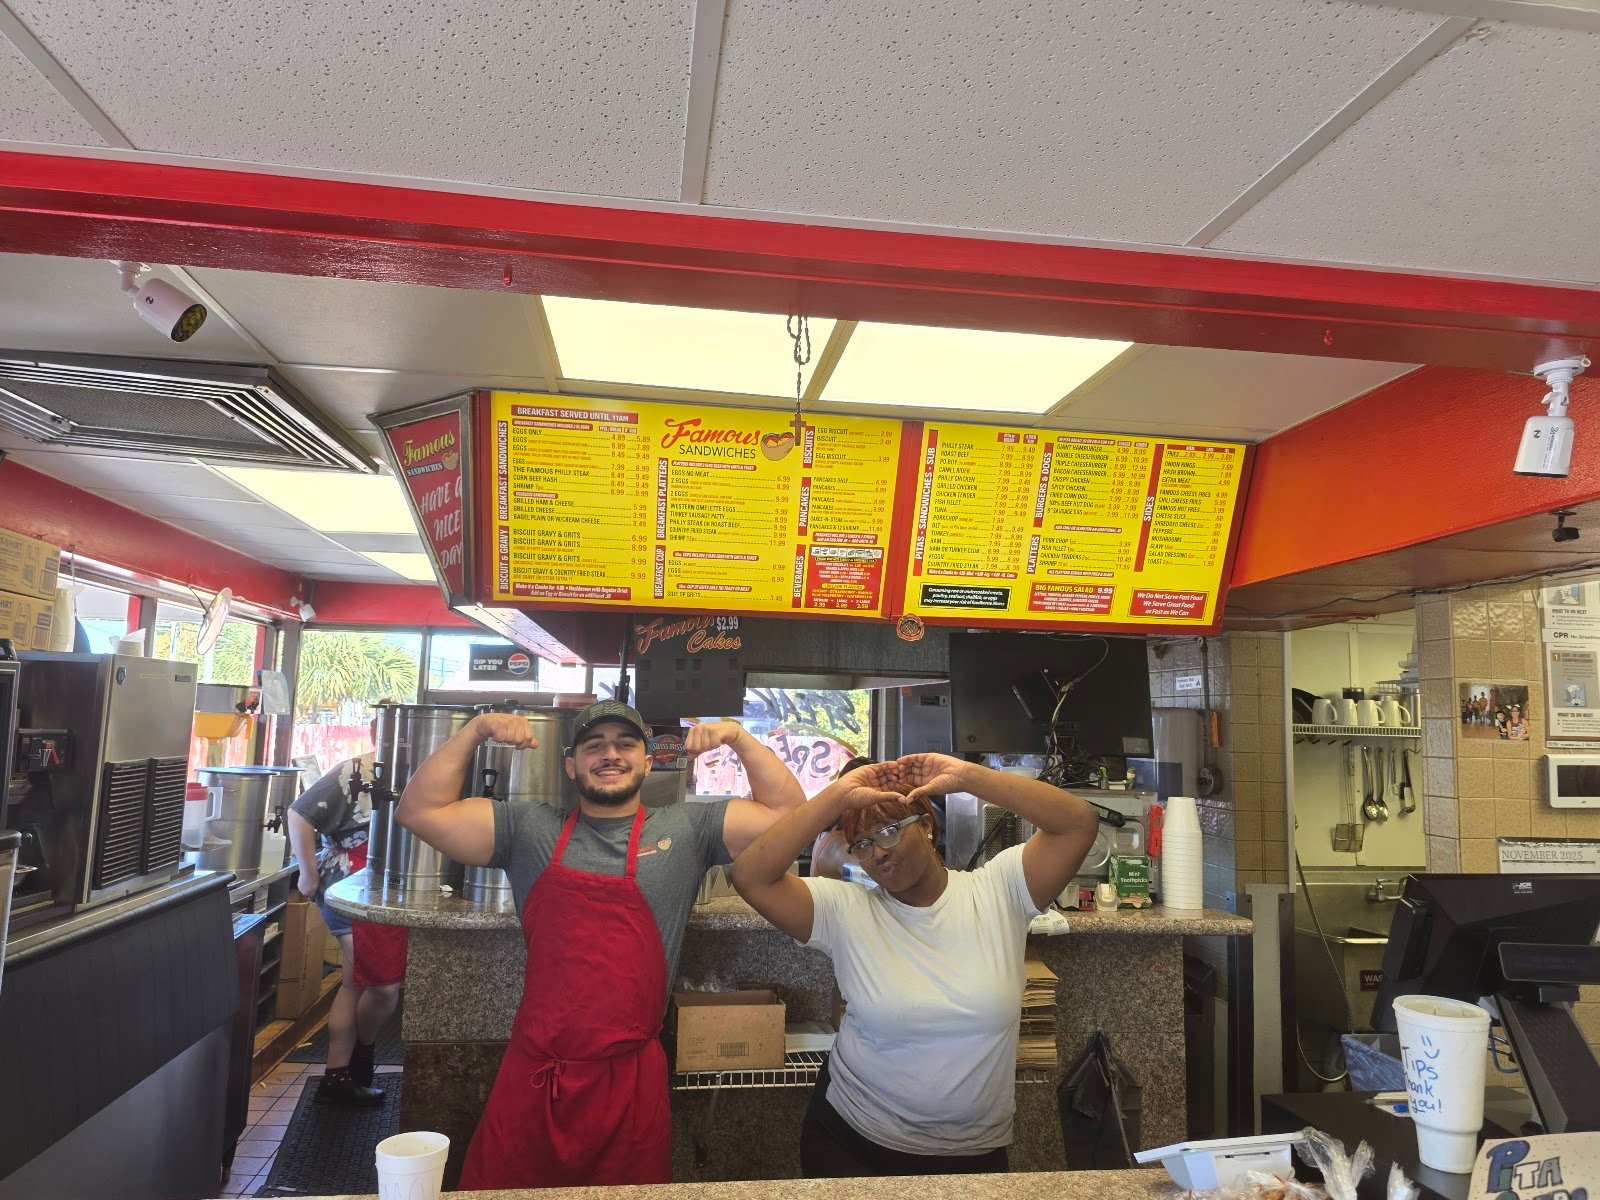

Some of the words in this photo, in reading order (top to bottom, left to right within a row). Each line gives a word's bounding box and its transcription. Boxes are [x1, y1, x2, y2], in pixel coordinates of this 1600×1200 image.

[517, 407, 559, 417] BREAKFAST
[560, 408, 588, 419] SERVED
[590, 412, 611, 421] UNTIL
[404, 429, 455, 467] Famous
[498, 421, 508, 475] SANDWICHES
[661, 418, 761, 449] Famous
[804, 430, 814, 464] BISCUITS
[679, 444, 756, 459] SANDWICHES
[927, 447, 936, 465] SUB
[407, 463, 443, 477] SANDWICHES
[526, 467, 553, 475] FAMOUS
[658, 459, 669, 493] PLATTERS
[1035, 482, 1047, 518] BURGERS
[1042, 452, 1052, 475] DOGS
[498, 475, 508, 520] BREAKFAST
[799, 486, 811, 527] PANCAKES
[918, 471, 932, 529] SANDWICHES
[1144, 496, 1154, 521] SIDES
[434, 509, 461, 542] NICE
[656, 493, 667, 539] BREAKFAST
[500, 529, 509, 554] GRAVY
[655, 547, 665, 563] CUP
[915, 536, 925, 560] PITAS
[1028, 536, 1039, 573] PLATTERS
[500, 560, 509, 590] BISCUIT
[654, 562, 664, 598] BREAKFAST
[793, 555, 804, 598] BEVERAGES
[1048, 585, 1073, 593] FAMOUS
[635, 616, 715, 654] Famous
[716, 616, 739, 631] $2.99
[687, 630, 742, 653] Cakes
[1502, 850, 1558, 860] NOVEMBER
[1560, 851, 1583, 860] 2025
